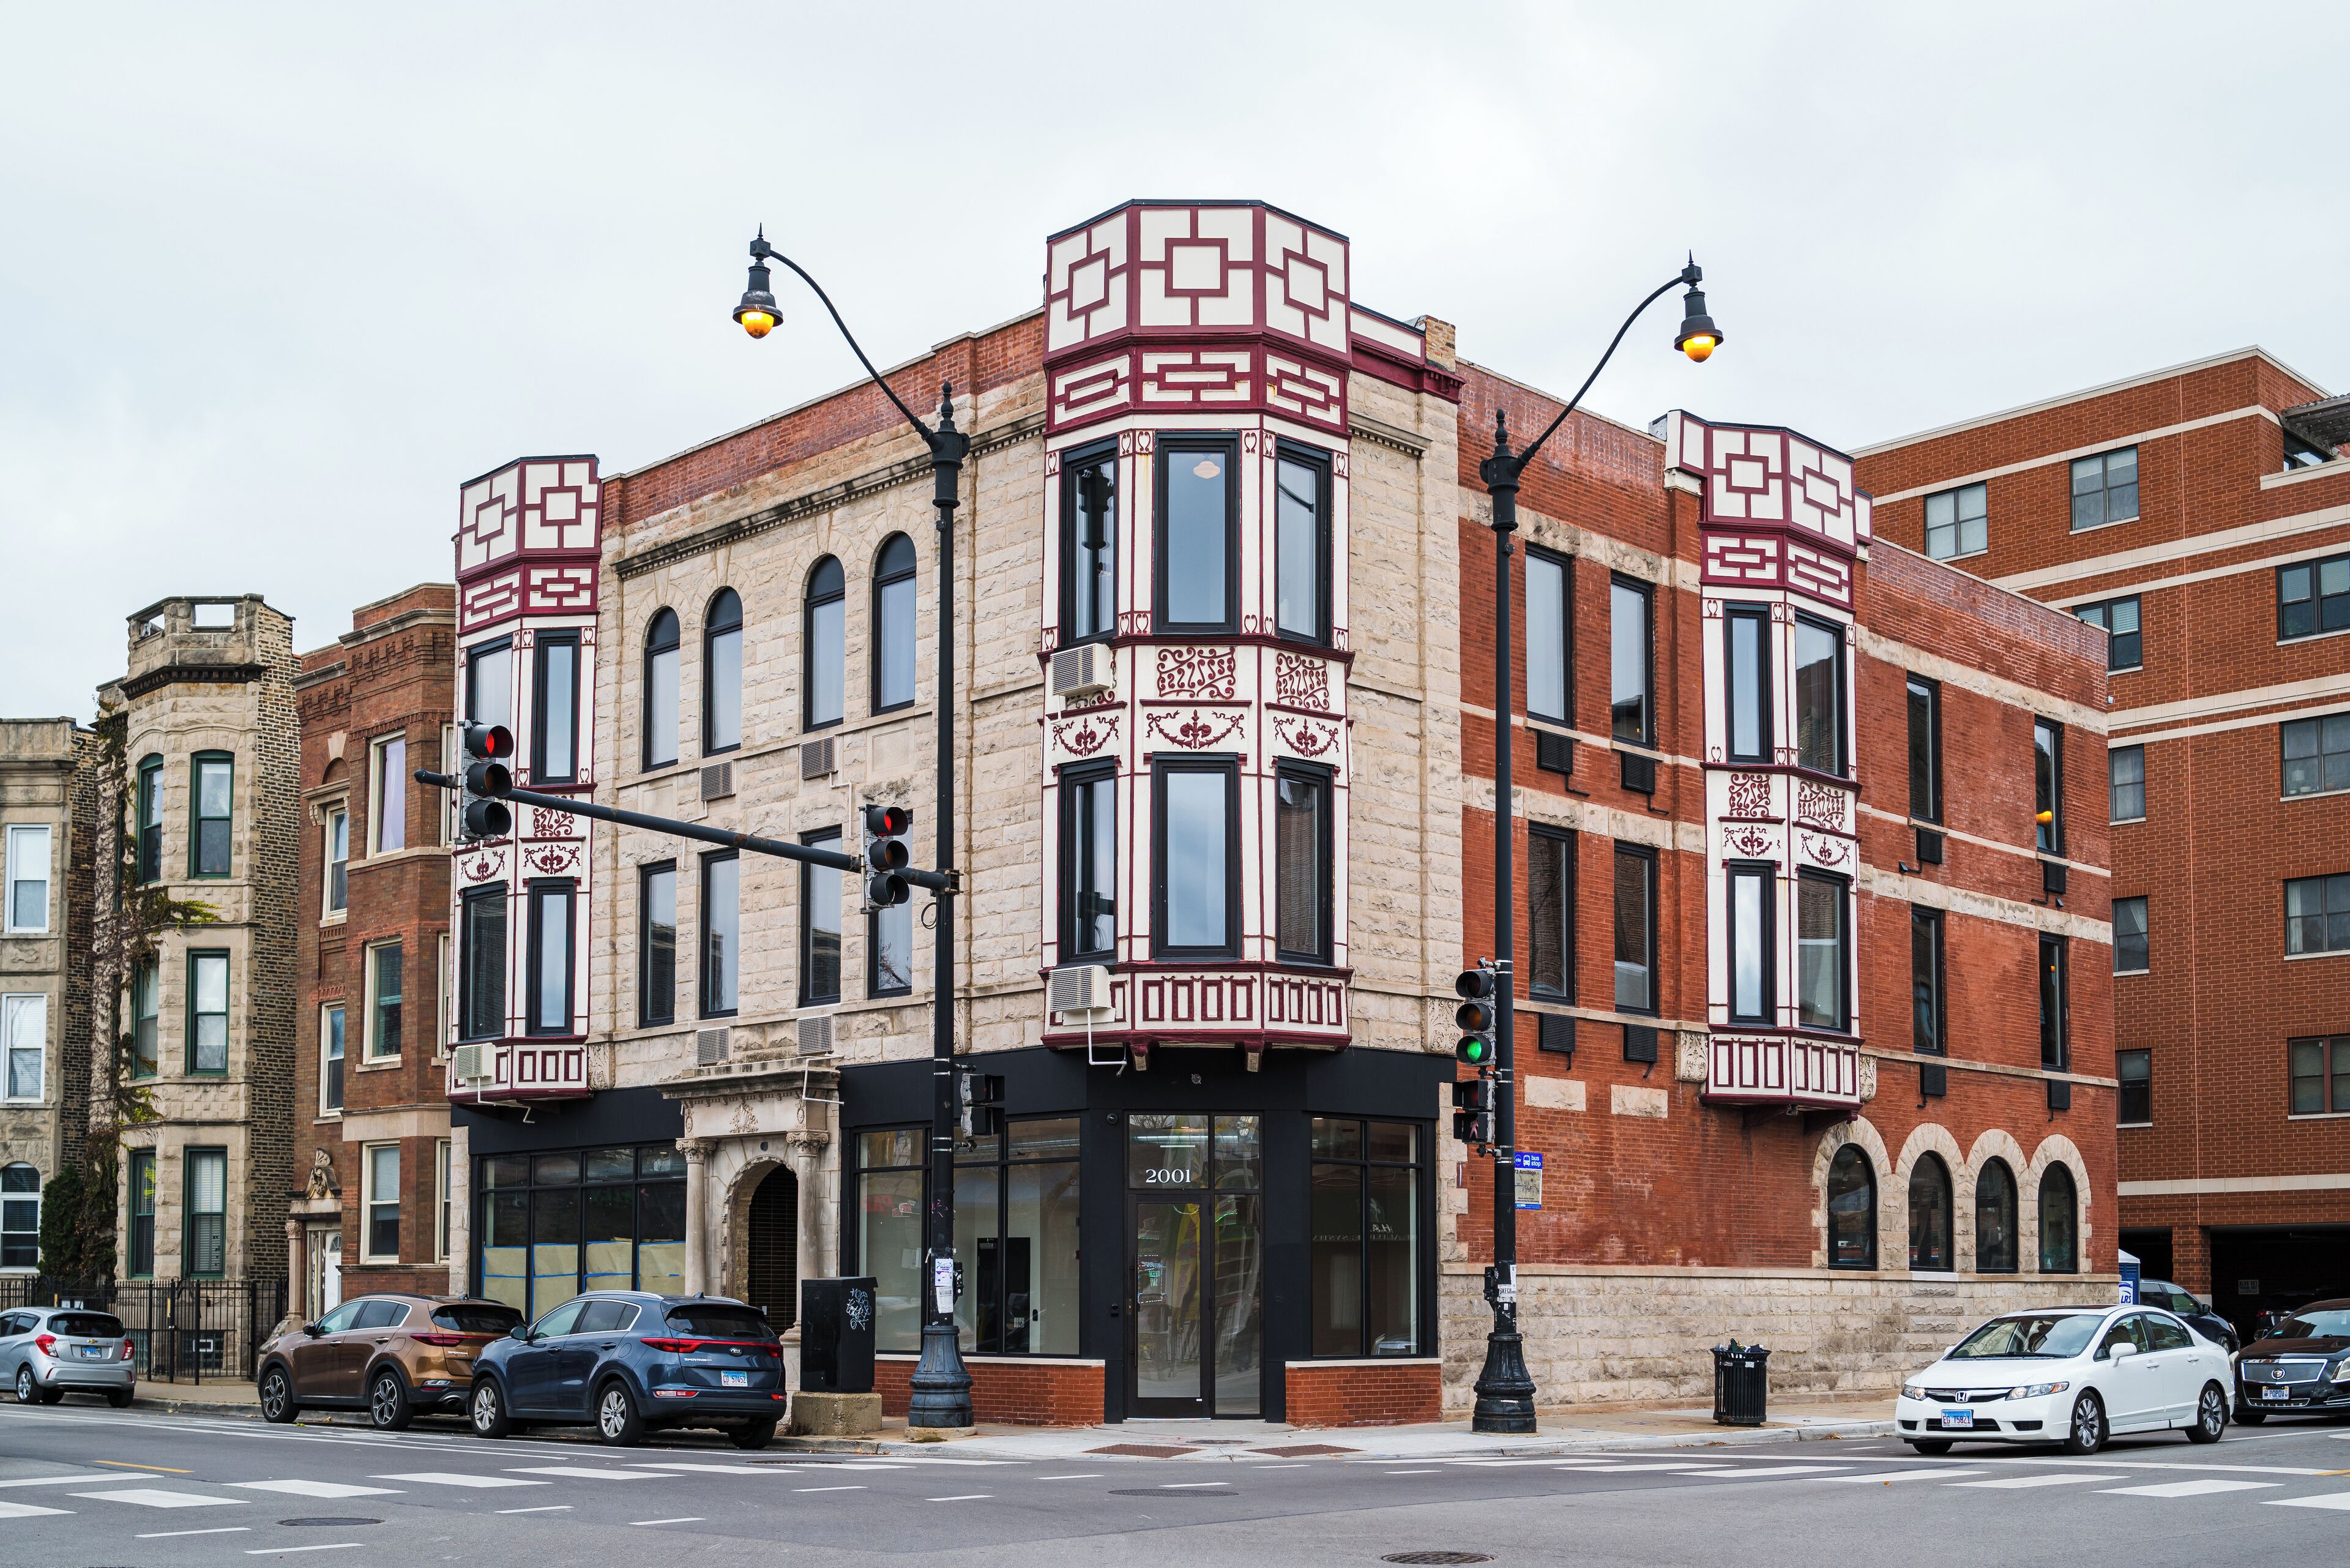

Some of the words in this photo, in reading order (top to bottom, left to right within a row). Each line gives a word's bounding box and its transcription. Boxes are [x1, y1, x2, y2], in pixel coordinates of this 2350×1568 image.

[1146, 1169, 1191, 1182] 2001
[2121, 1295, 2132, 1304] LRS
[1942, 1415, 1950, 1424] EG
[1952, 1415, 1971, 1424] 75821
